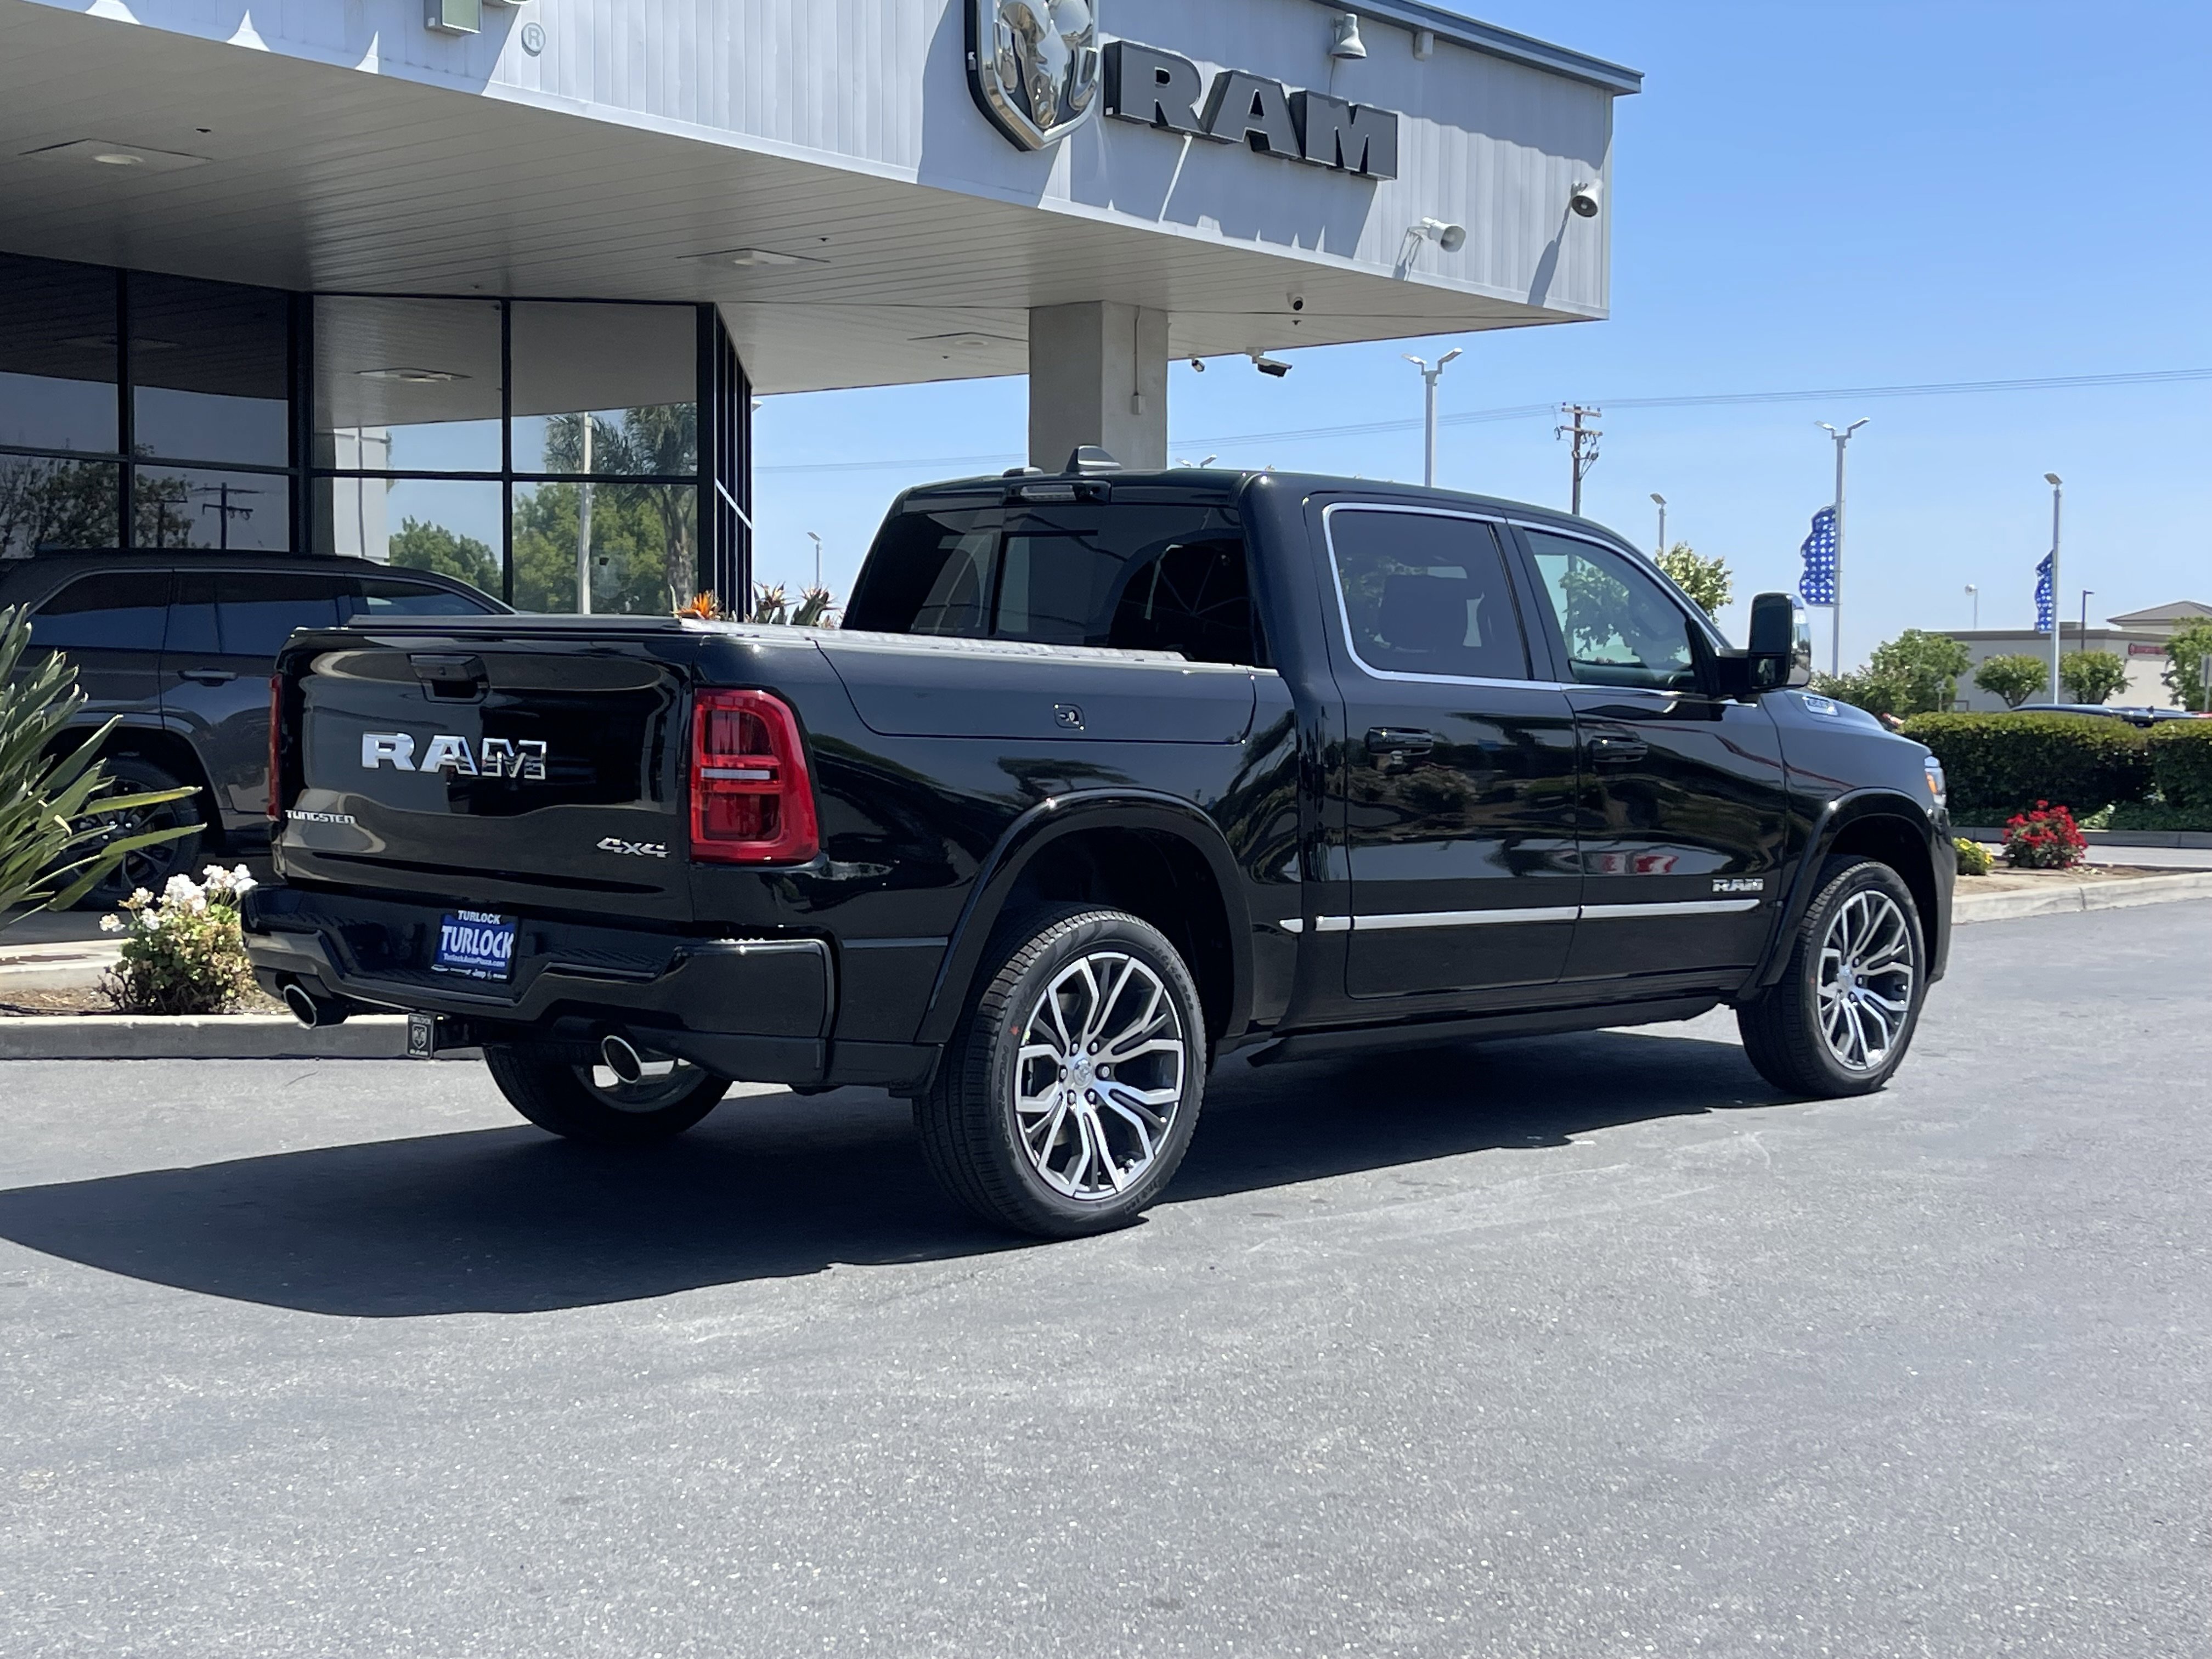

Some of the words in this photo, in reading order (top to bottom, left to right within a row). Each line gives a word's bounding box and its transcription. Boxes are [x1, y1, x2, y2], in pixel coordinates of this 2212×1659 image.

[1104, 41, 1398, 180] RAM
[362, 731, 546, 780] RAM
[285, 809, 356, 824] TUNGSTEN
[1712, 878, 1763, 892] RAM
[458, 910, 501, 924] TURLOCK
[441, 925, 514, 959] TURLOCK
